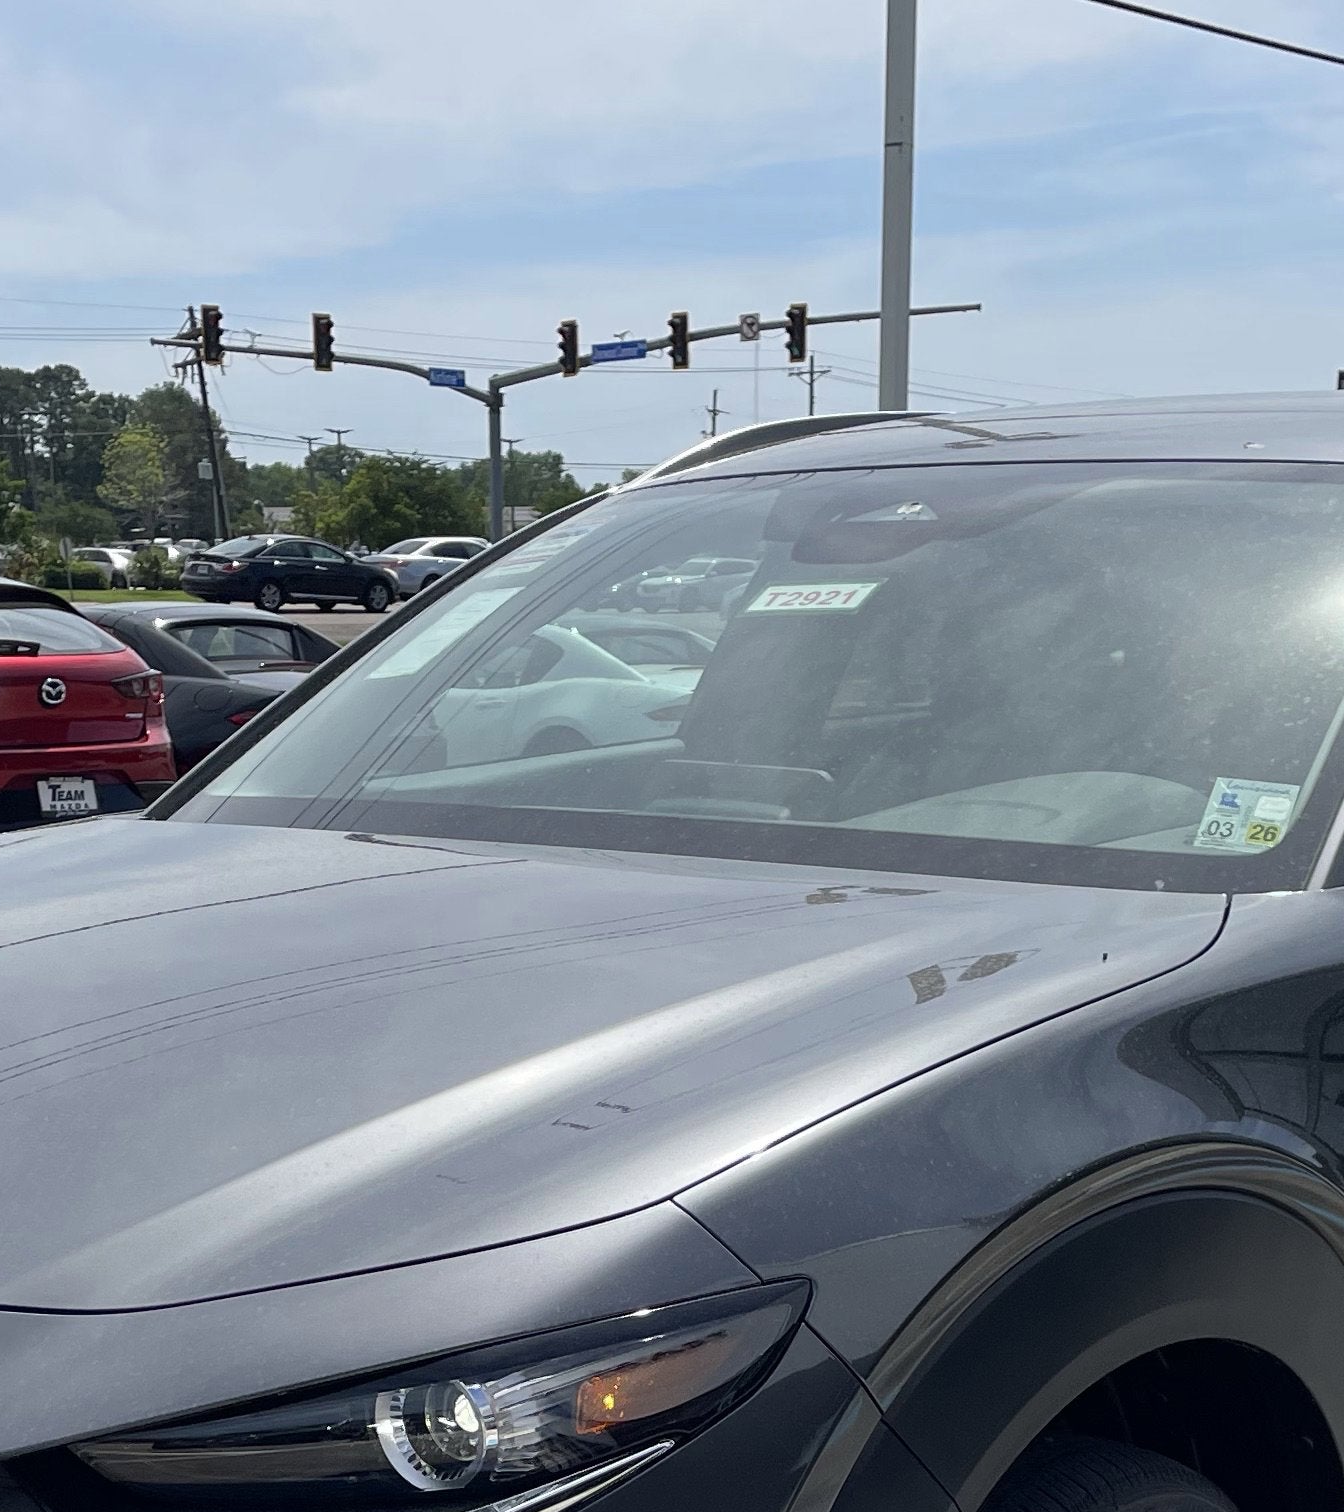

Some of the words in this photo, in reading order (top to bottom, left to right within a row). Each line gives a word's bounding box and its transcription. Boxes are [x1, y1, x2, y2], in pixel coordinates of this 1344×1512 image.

[764, 590, 859, 608] T2921
[48, 784, 86, 802] TEAM
[49, 802, 90, 811] MAZDA
[1207, 820, 1235, 839] 03
[1248, 823, 1279, 842] 26
